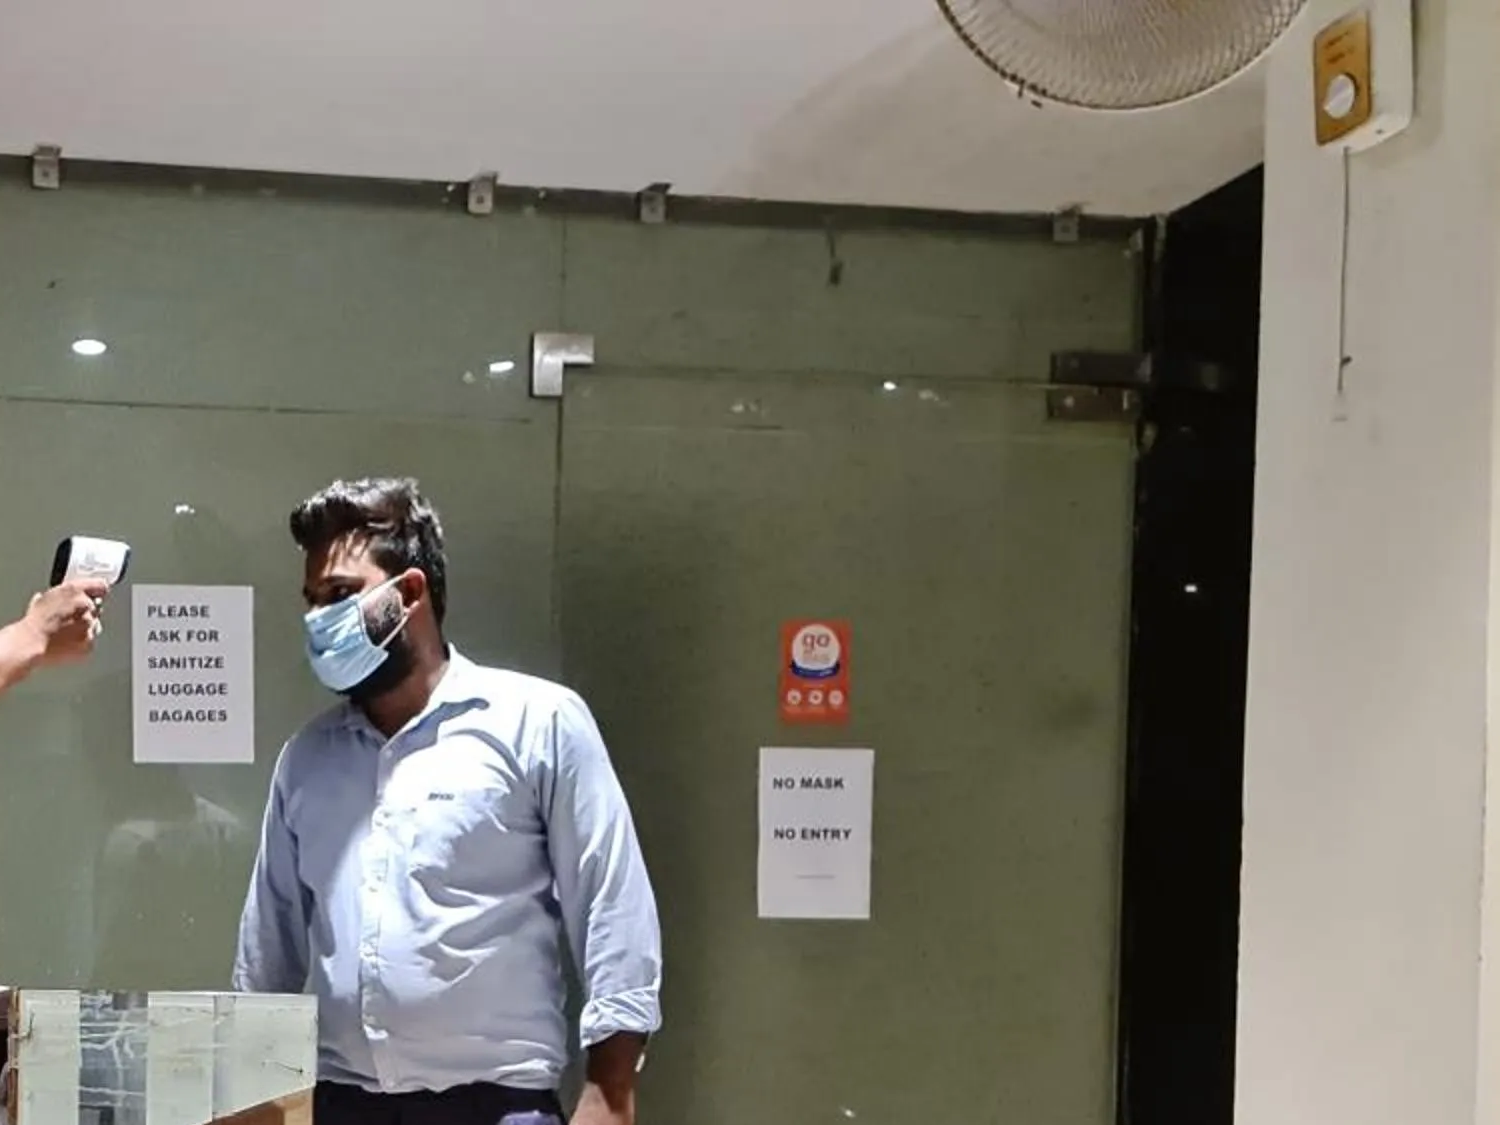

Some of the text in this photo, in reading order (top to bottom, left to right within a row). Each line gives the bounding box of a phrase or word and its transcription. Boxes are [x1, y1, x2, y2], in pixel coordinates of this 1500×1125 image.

[147, 605, 210, 618] PLEASE
[147, 630, 219, 643] ASK FOR
[148, 656, 224, 669] SANITIZE
[148, 683, 228, 696] LUGGAGE
[149, 710, 227, 722] BAGAGES
[773, 777, 844, 789] NO MASK
[774, 828, 852, 841] NO ENTRY
